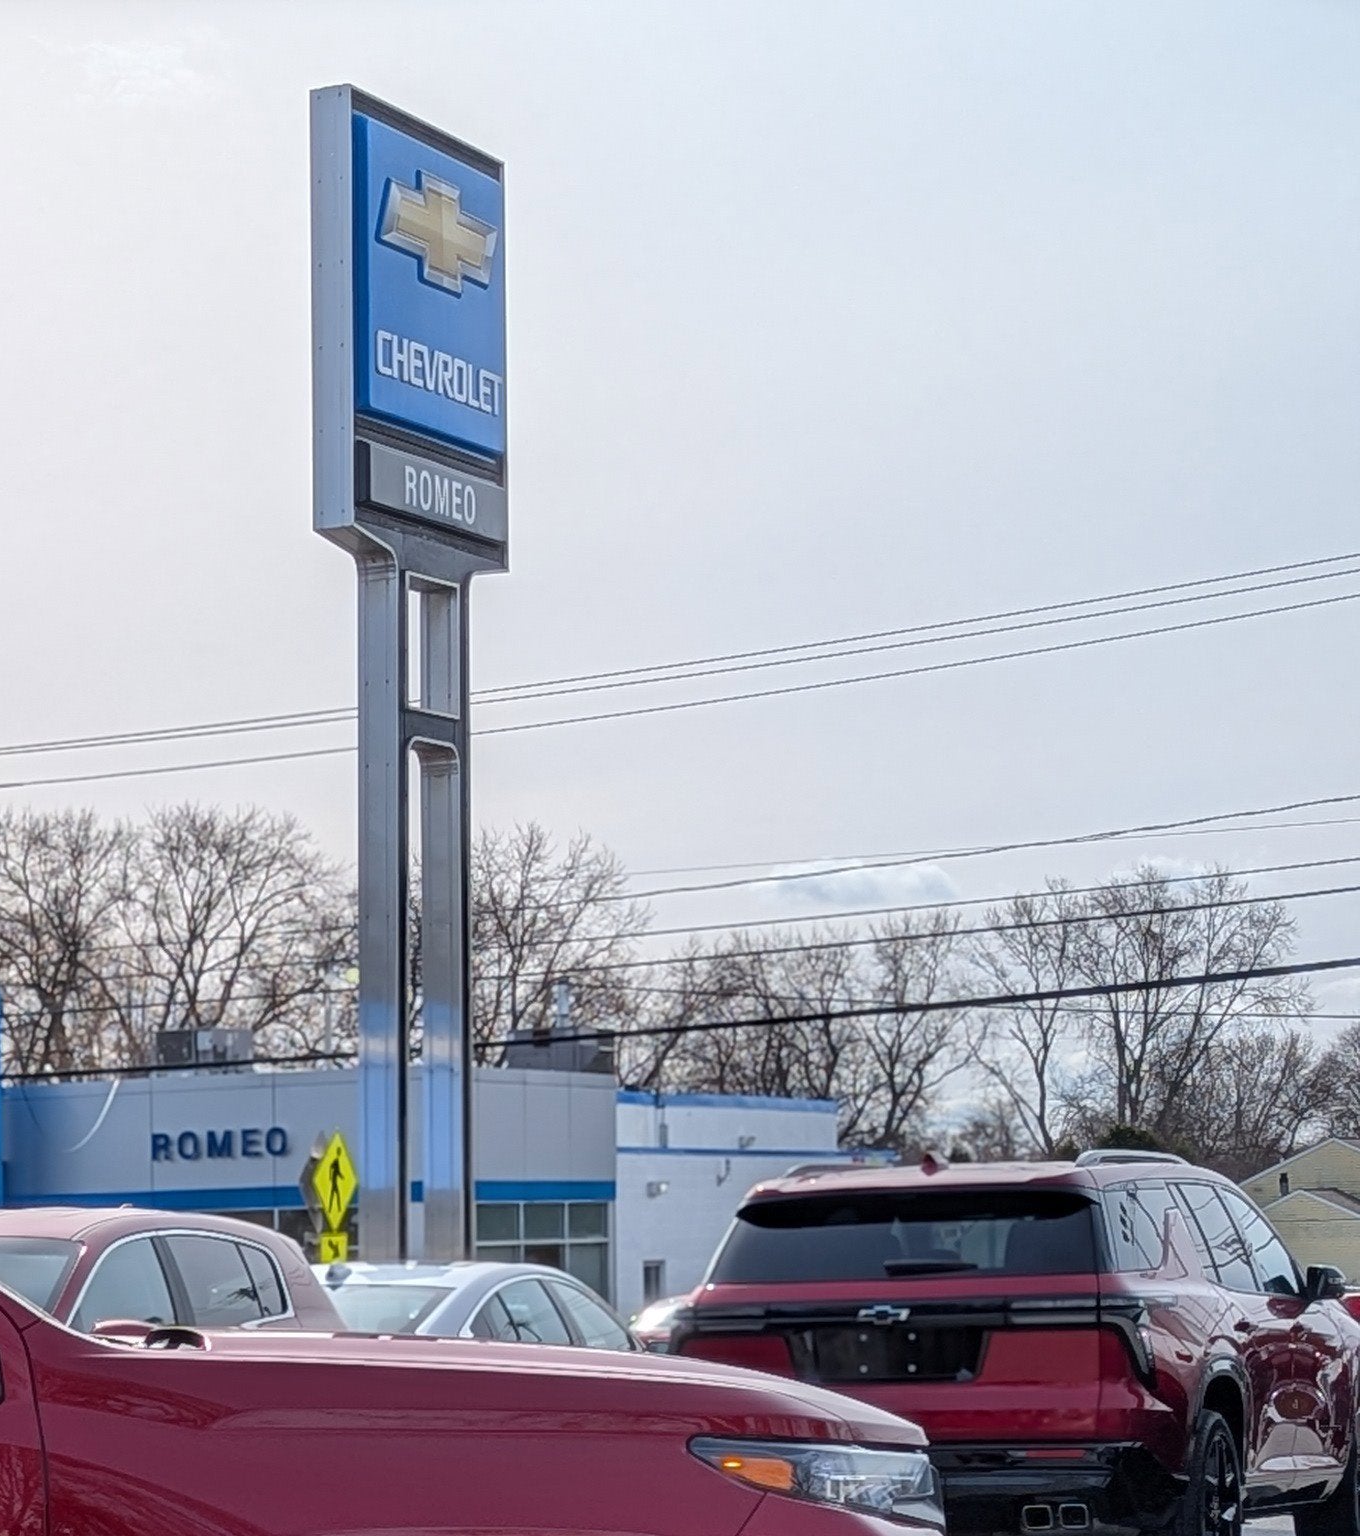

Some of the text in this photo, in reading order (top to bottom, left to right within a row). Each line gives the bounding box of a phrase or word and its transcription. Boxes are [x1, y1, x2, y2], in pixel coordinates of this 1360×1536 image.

[376, 329, 503, 416] CHEVROLET
[404, 465, 476, 526] ROMEO
[151, 1126, 289, 1162] ROMEO
